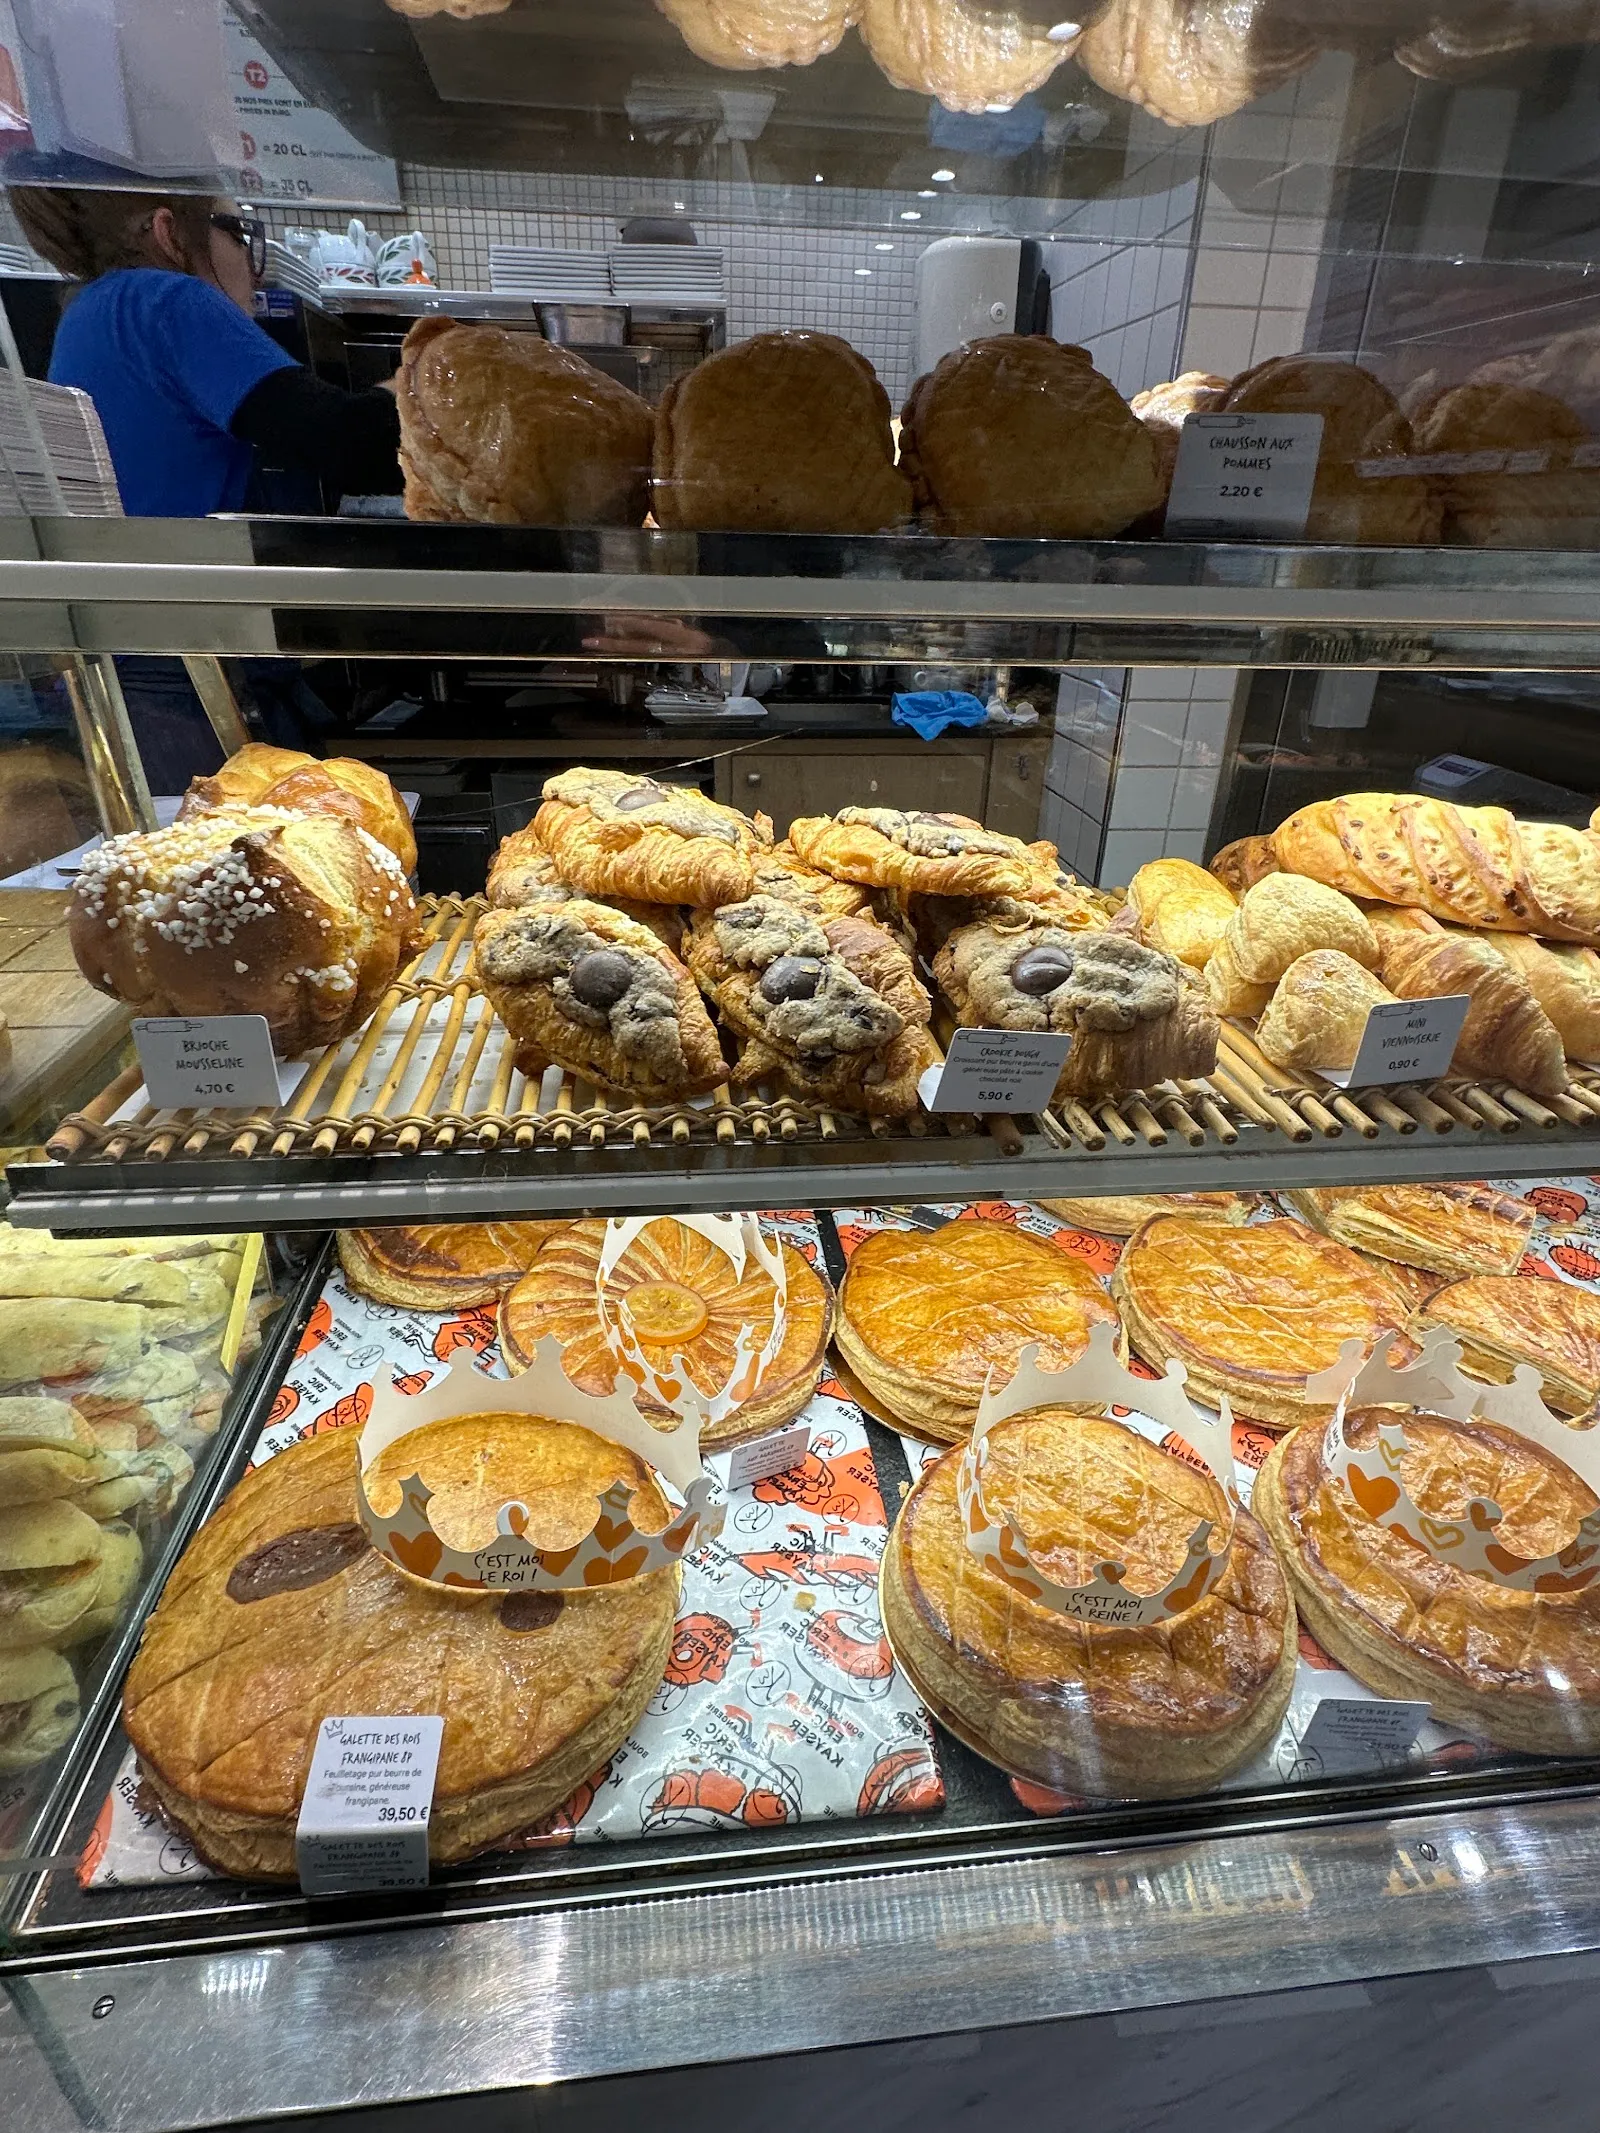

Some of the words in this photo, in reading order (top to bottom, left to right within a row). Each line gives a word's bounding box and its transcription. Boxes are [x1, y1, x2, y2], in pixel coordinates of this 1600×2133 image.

[273, 143, 288, 155] 20
[291, 144, 307, 156] CL
[1209, 436, 1267, 449] CHAUSSON
[1270, 437, 1294, 450] AUX
[1223, 456, 1272, 470] POMMES
[1254, 486, 1263, 497] €
[1405, 1018, 1427, 1030] MINI
[182, 1040, 230, 1052] BRIOCHE
[1382, 1032, 1442, 1049] VIENNOISERIE
[176, 1058, 244, 1070] MOUSSELINE
[1388, 1060, 1410, 1071] 0,90
[1411, 1058, 1420, 1067] €
[195, 1084, 222, 1095] 4,70
[226, 1083, 236, 1093] €
[978, 1091, 1003, 1101] 5,90
[1005, 1092, 1014, 1101] €
[475, 1552, 516, 1568] C'EST
[517, 1554, 544, 1567] MOI
[480, 1570, 496, 1583] LE
[502, 1571, 524, 1583] ROI
[1072, 1592, 1114, 1608] C'EST
[1114, 1599, 1142, 1609] MOI
[1065, 1602, 1082, 1615] LA
[1088, 1608, 1131, 1622] REINE
[340, 1733, 383, 1746] GALETTE
[384, 1732, 400, 1745] DES
[402, 1732, 421, 1745] ROIS
[341, 1752, 399, 1766] FRANGIPANE
[324, 1769, 367, 1779] Feuilletage
[368, 1770, 382, 1779] pur
[384, 1769, 410, 1778] beurre
[411, 1768, 422, 1777] de
[369, 1783, 411, 1793] généreuse
[378, 1807, 416, 1823] 39,50
[420, 1806, 429, 1820] €
